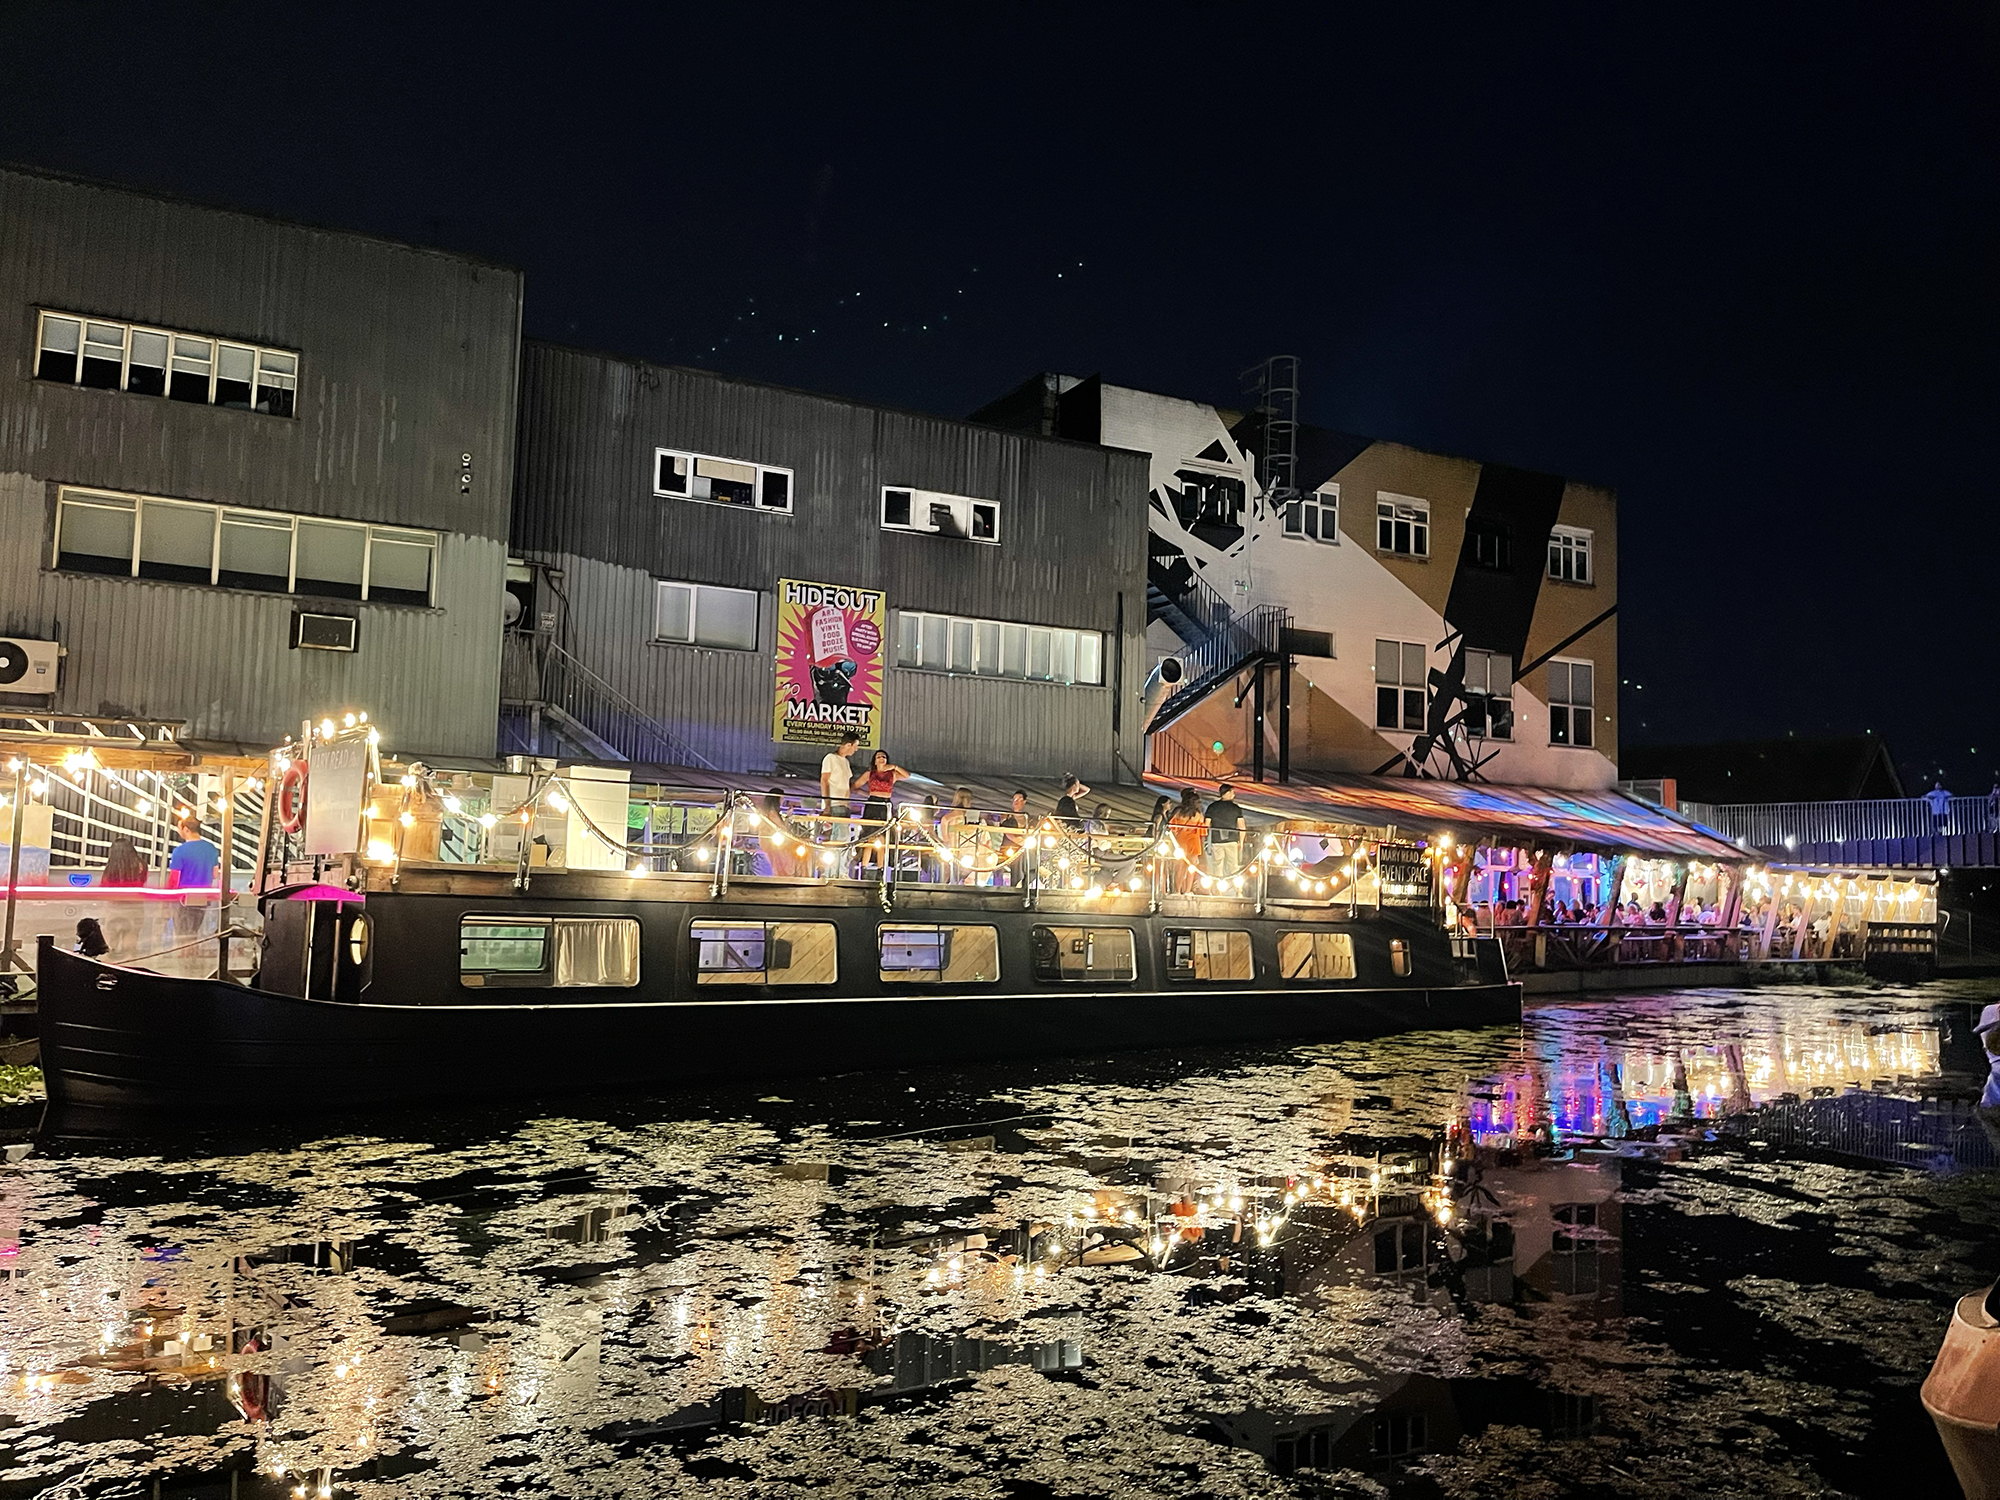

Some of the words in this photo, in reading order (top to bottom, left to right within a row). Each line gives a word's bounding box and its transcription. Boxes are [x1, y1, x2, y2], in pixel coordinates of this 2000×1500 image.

[785, 583, 879, 613] HIDEOUT
[822, 609, 835, 617] ART
[815, 616, 842, 626] FASHION
[820, 624, 840, 632] VINYL
[823, 631, 840, 639] FOOD
[822, 638, 843, 647] BOOZE
[823, 645, 845, 654] MUSIC
[786, 701, 871, 724] MARKET
[330, 749, 349, 769] READ
[1381, 848, 1400, 862] MARY
[1401, 850, 1419, 863] READ
[1381, 864, 1405, 882] EVENT
[1406, 866, 1428, 883] SPACE
